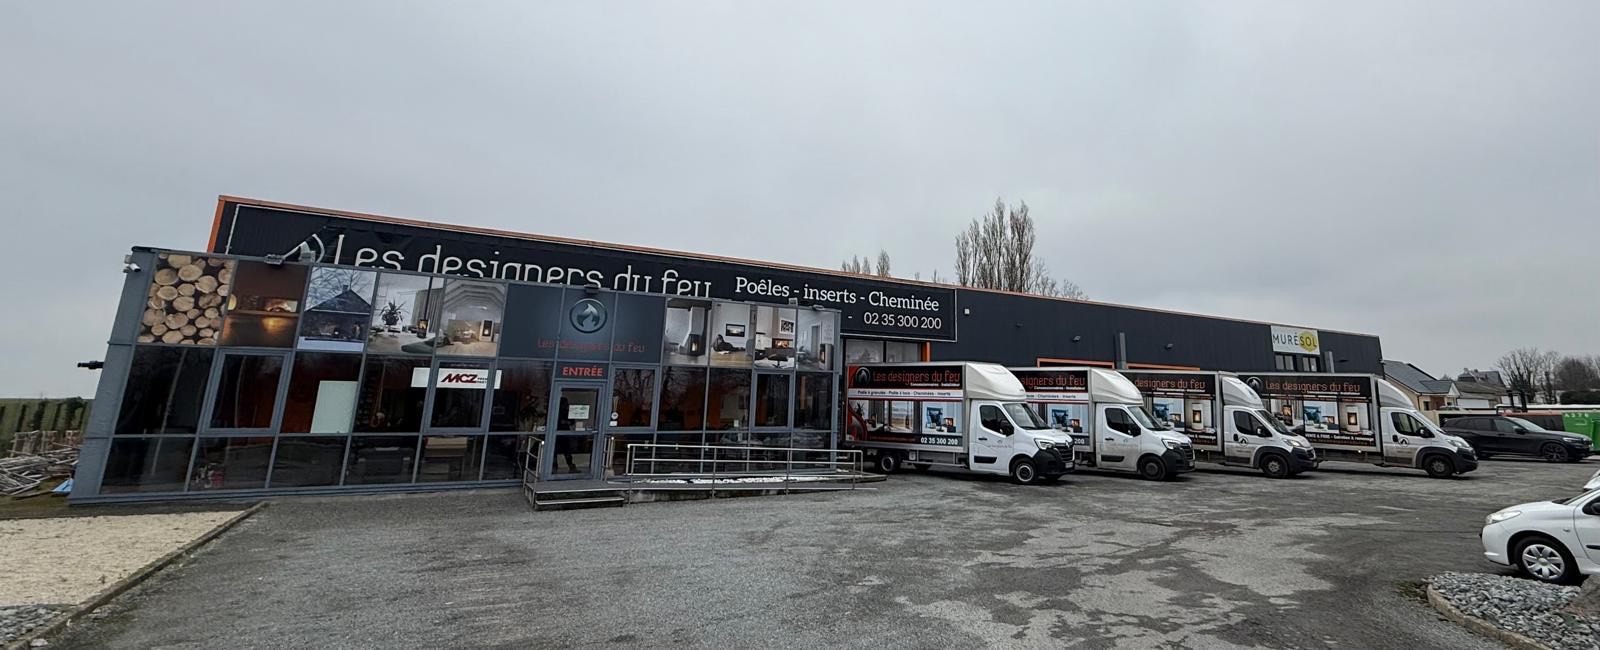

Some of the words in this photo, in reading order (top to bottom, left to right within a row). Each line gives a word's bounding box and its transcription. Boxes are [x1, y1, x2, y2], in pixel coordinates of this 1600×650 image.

[334, 233, 404, 271] Les
[418, 245, 604, 289] designers
[614, 265, 652, 295] du
[661, 269, 712, 298] feu
[736, 276, 790, 298] Poêles
[803, 283, 857, 304] inserts
[868, 291, 940, 312] Cheminée
[863, 312, 879, 325] 02
[881, 313, 895, 326] 35
[897, 314, 918, 328] 300
[920, 316, 942, 330] 200
[1272, 331, 1318, 348] MURÉSOL
[627, 343, 645, 353] feu
[562, 365, 603, 377] ENTRÉE
[873, 371, 886, 382] Les
[888, 371, 929, 386] designers
[931, 370, 942, 382] du
[944, 370, 960, 383] feu
[441, 373, 478, 384] MCZ
[1056, 375, 1067, 386] du
[1069, 375, 1086, 386] feu
[1178, 379, 1187, 389] du
[1265, 380, 1281, 390] Les
[1282, 381, 1328, 394] designers
[1330, 381, 1341, 392] du
[1343, 382, 1361, 392] feu
